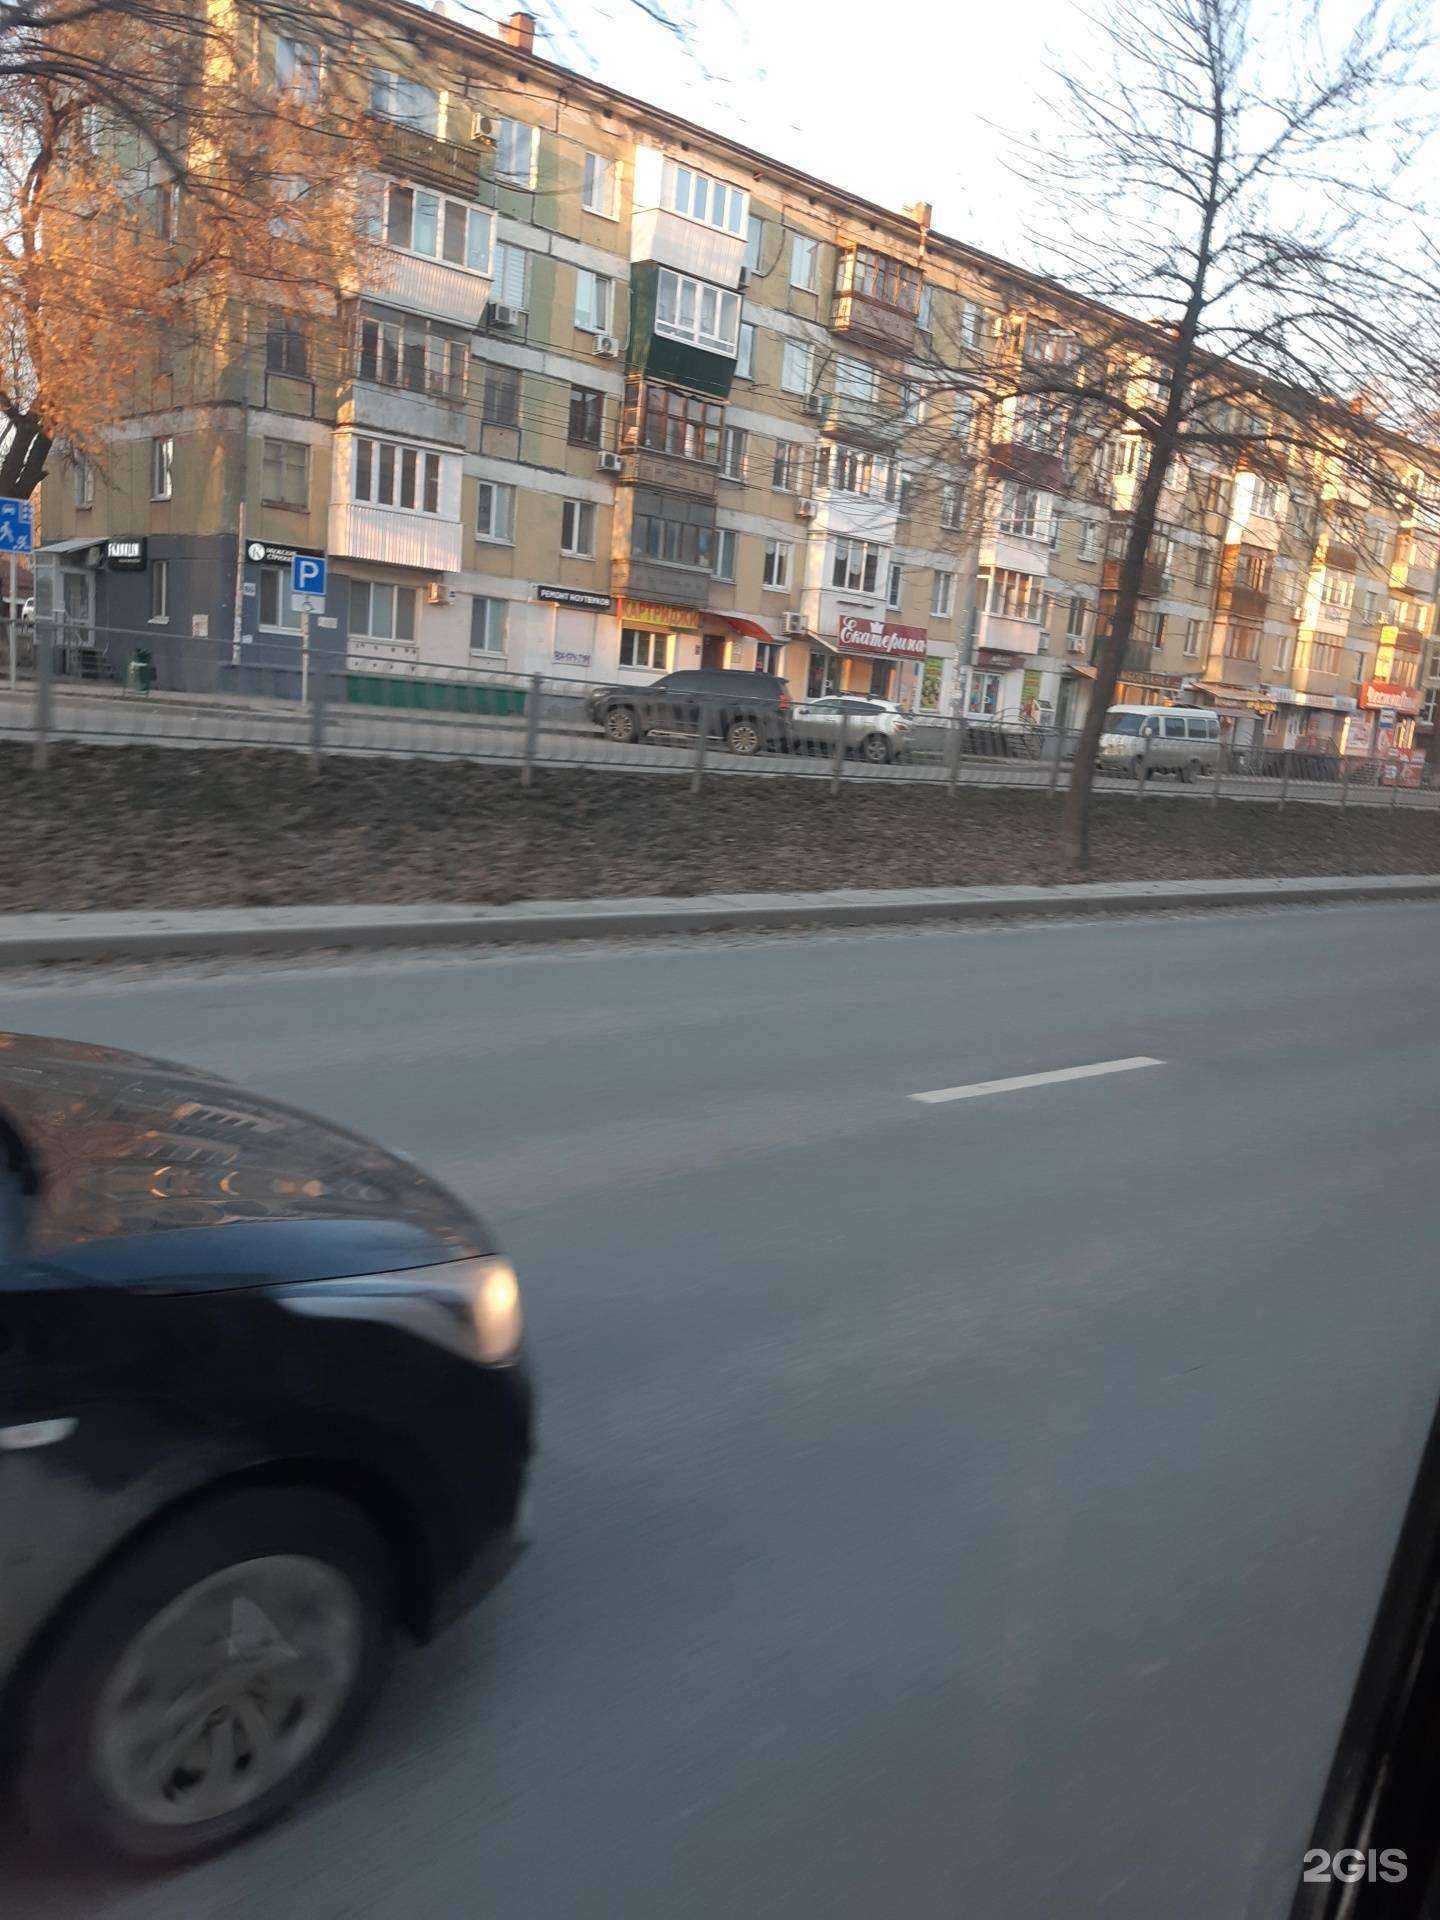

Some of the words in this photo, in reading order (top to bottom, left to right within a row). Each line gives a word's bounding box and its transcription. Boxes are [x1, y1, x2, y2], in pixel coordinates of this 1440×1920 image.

[300, 560, 319, 589] P
[540, 589, 570, 601] РЕМОНТ
[570, 593, 610, 606] НОУТБУКОВ
[622, 601, 700, 627] КАРТРИДЖИ
[840, 616, 926, 653] Екатерина
